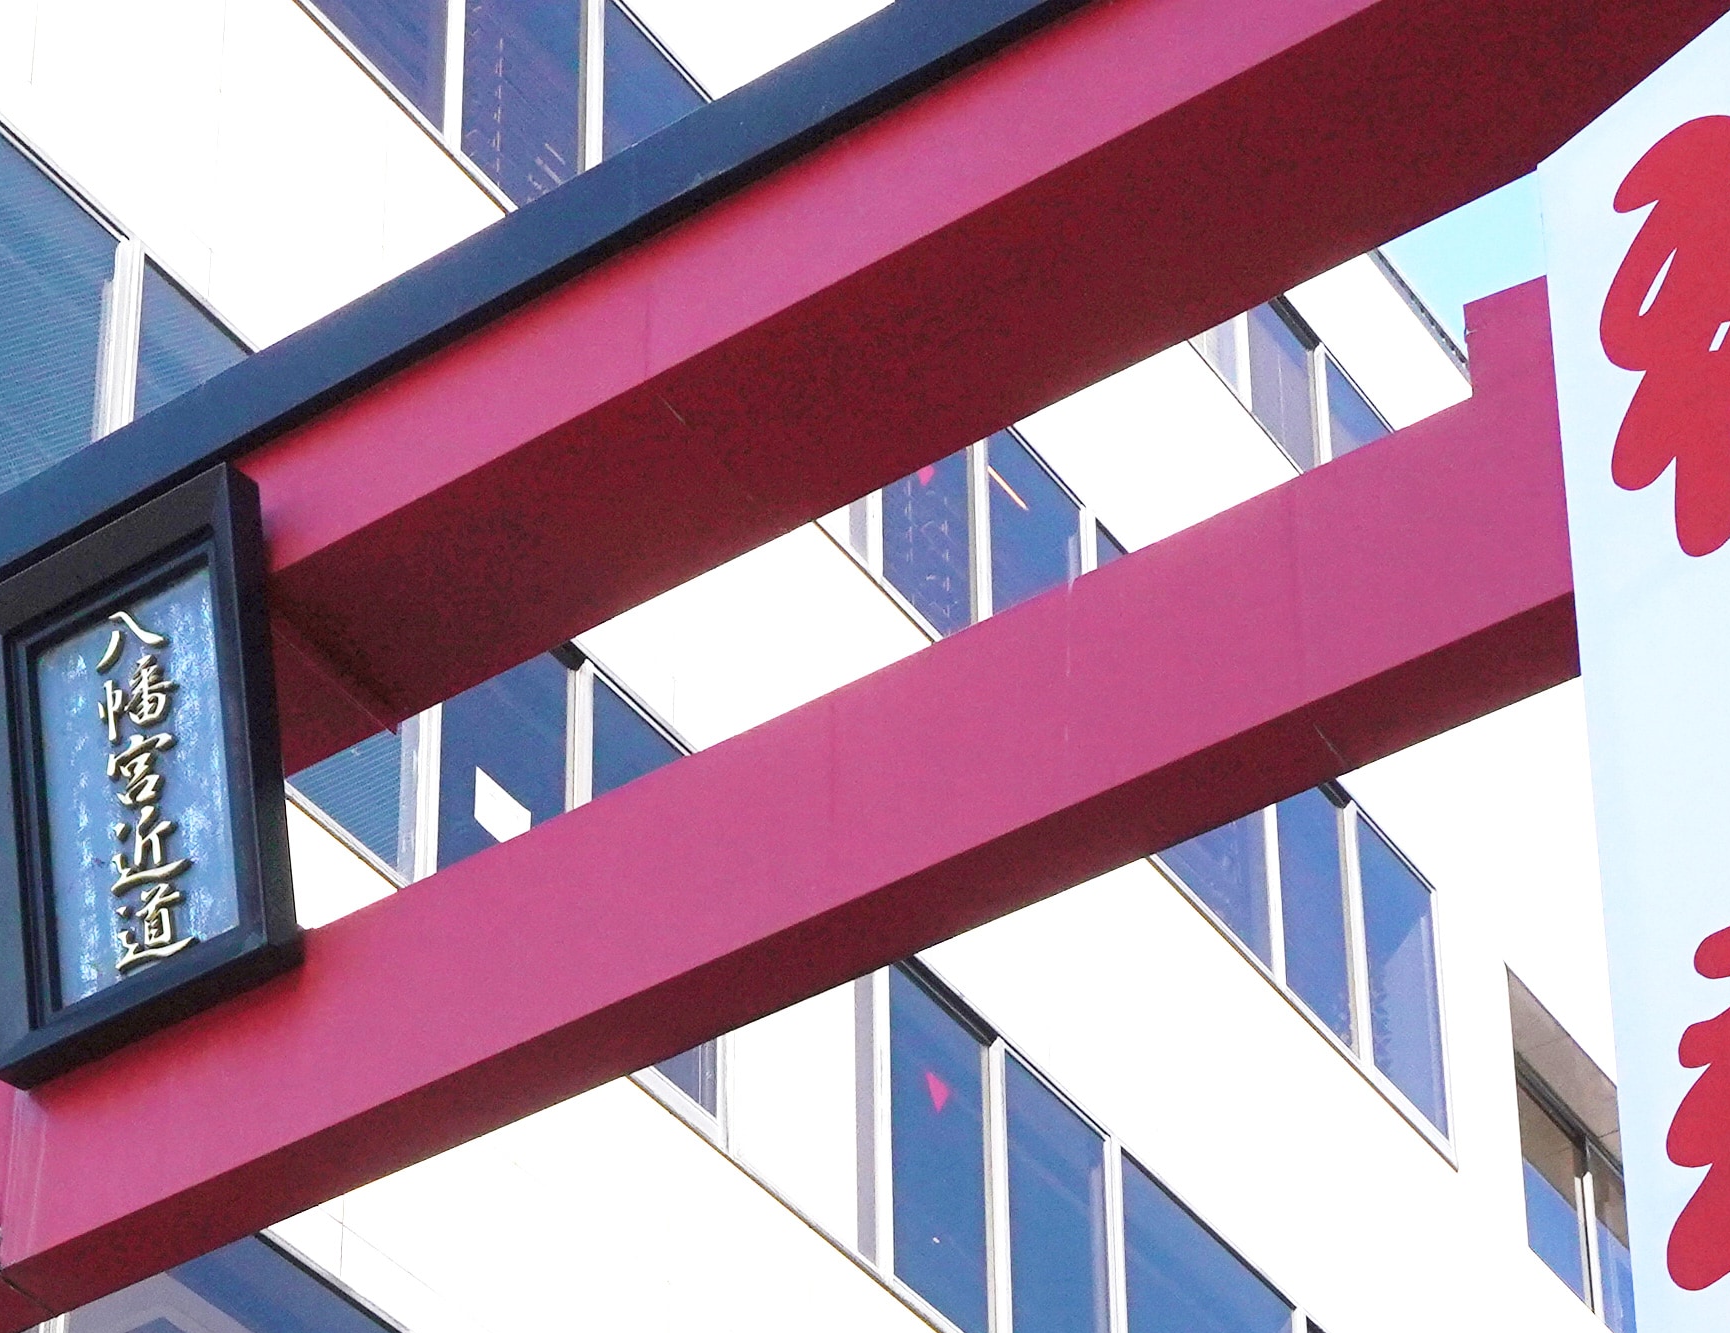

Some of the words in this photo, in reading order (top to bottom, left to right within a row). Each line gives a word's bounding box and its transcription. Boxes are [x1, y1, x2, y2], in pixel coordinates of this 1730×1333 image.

[97, 610, 199, 973] 八幡宮近道
